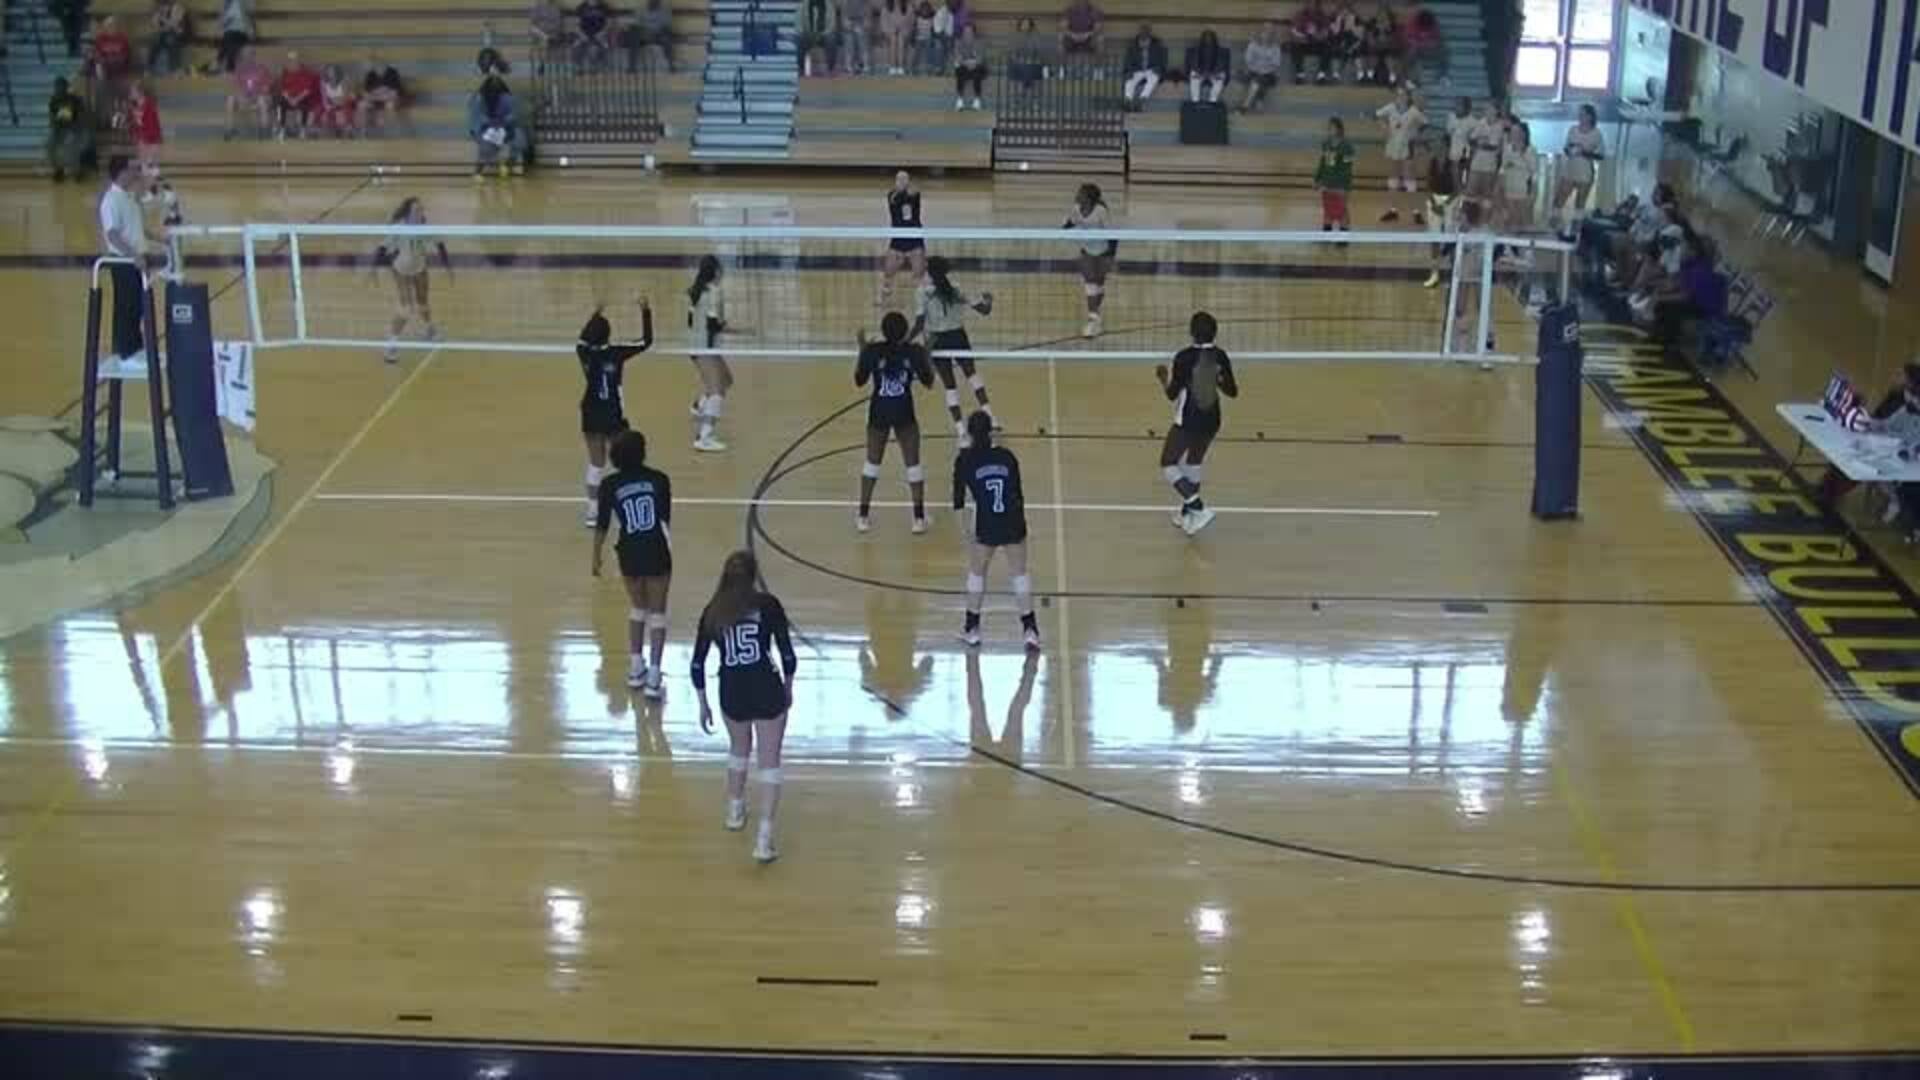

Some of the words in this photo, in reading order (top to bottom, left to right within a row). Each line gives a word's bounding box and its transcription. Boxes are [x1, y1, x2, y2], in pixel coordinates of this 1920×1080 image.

[622, 495, 655, 535] 10
[985, 478, 1005, 513] 7
[722, 623, 761, 667] 15
